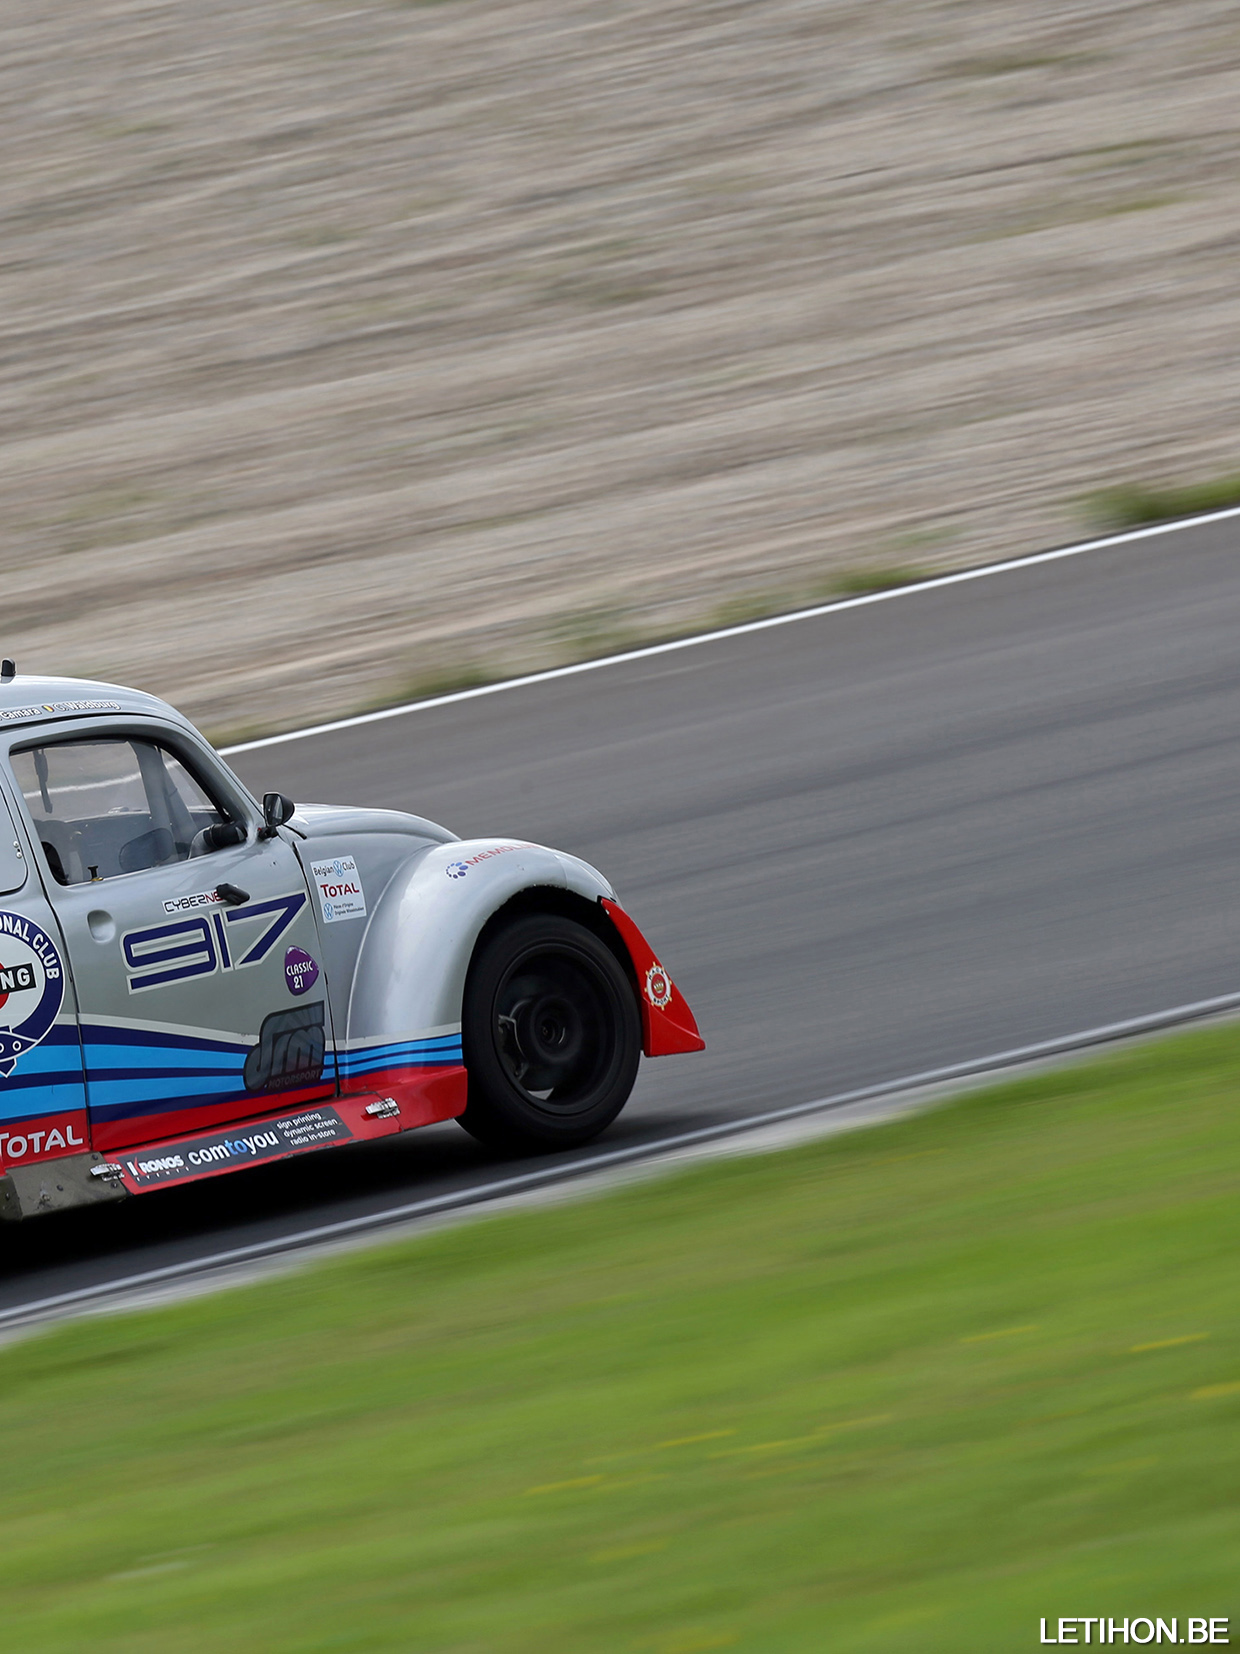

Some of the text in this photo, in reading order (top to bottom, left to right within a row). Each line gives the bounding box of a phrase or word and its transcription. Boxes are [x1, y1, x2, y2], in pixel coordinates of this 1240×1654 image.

[313, 866, 335, 877] Belgian
[342, 861, 356, 871] Club
[320, 882, 360, 898] TOTAL
[164, 890, 223, 913] CYBERNE
[122, 890, 308, 994] 917
[32, 933, 61, 980] CLUB
[286, 960, 314, 977] CLASSIC
[293, 974, 304, 989] 21
[269, 1069, 322, 1088] MOTORSPORT
[277, 1112, 322, 1130] sign printing
[283, 1118, 338, 1138] dynamic screen
[290, 1129, 336, 1147] radio in-store
[126, 1154, 184, 1177] KRONOS
[188, 1129, 279, 1166] comtoyou
